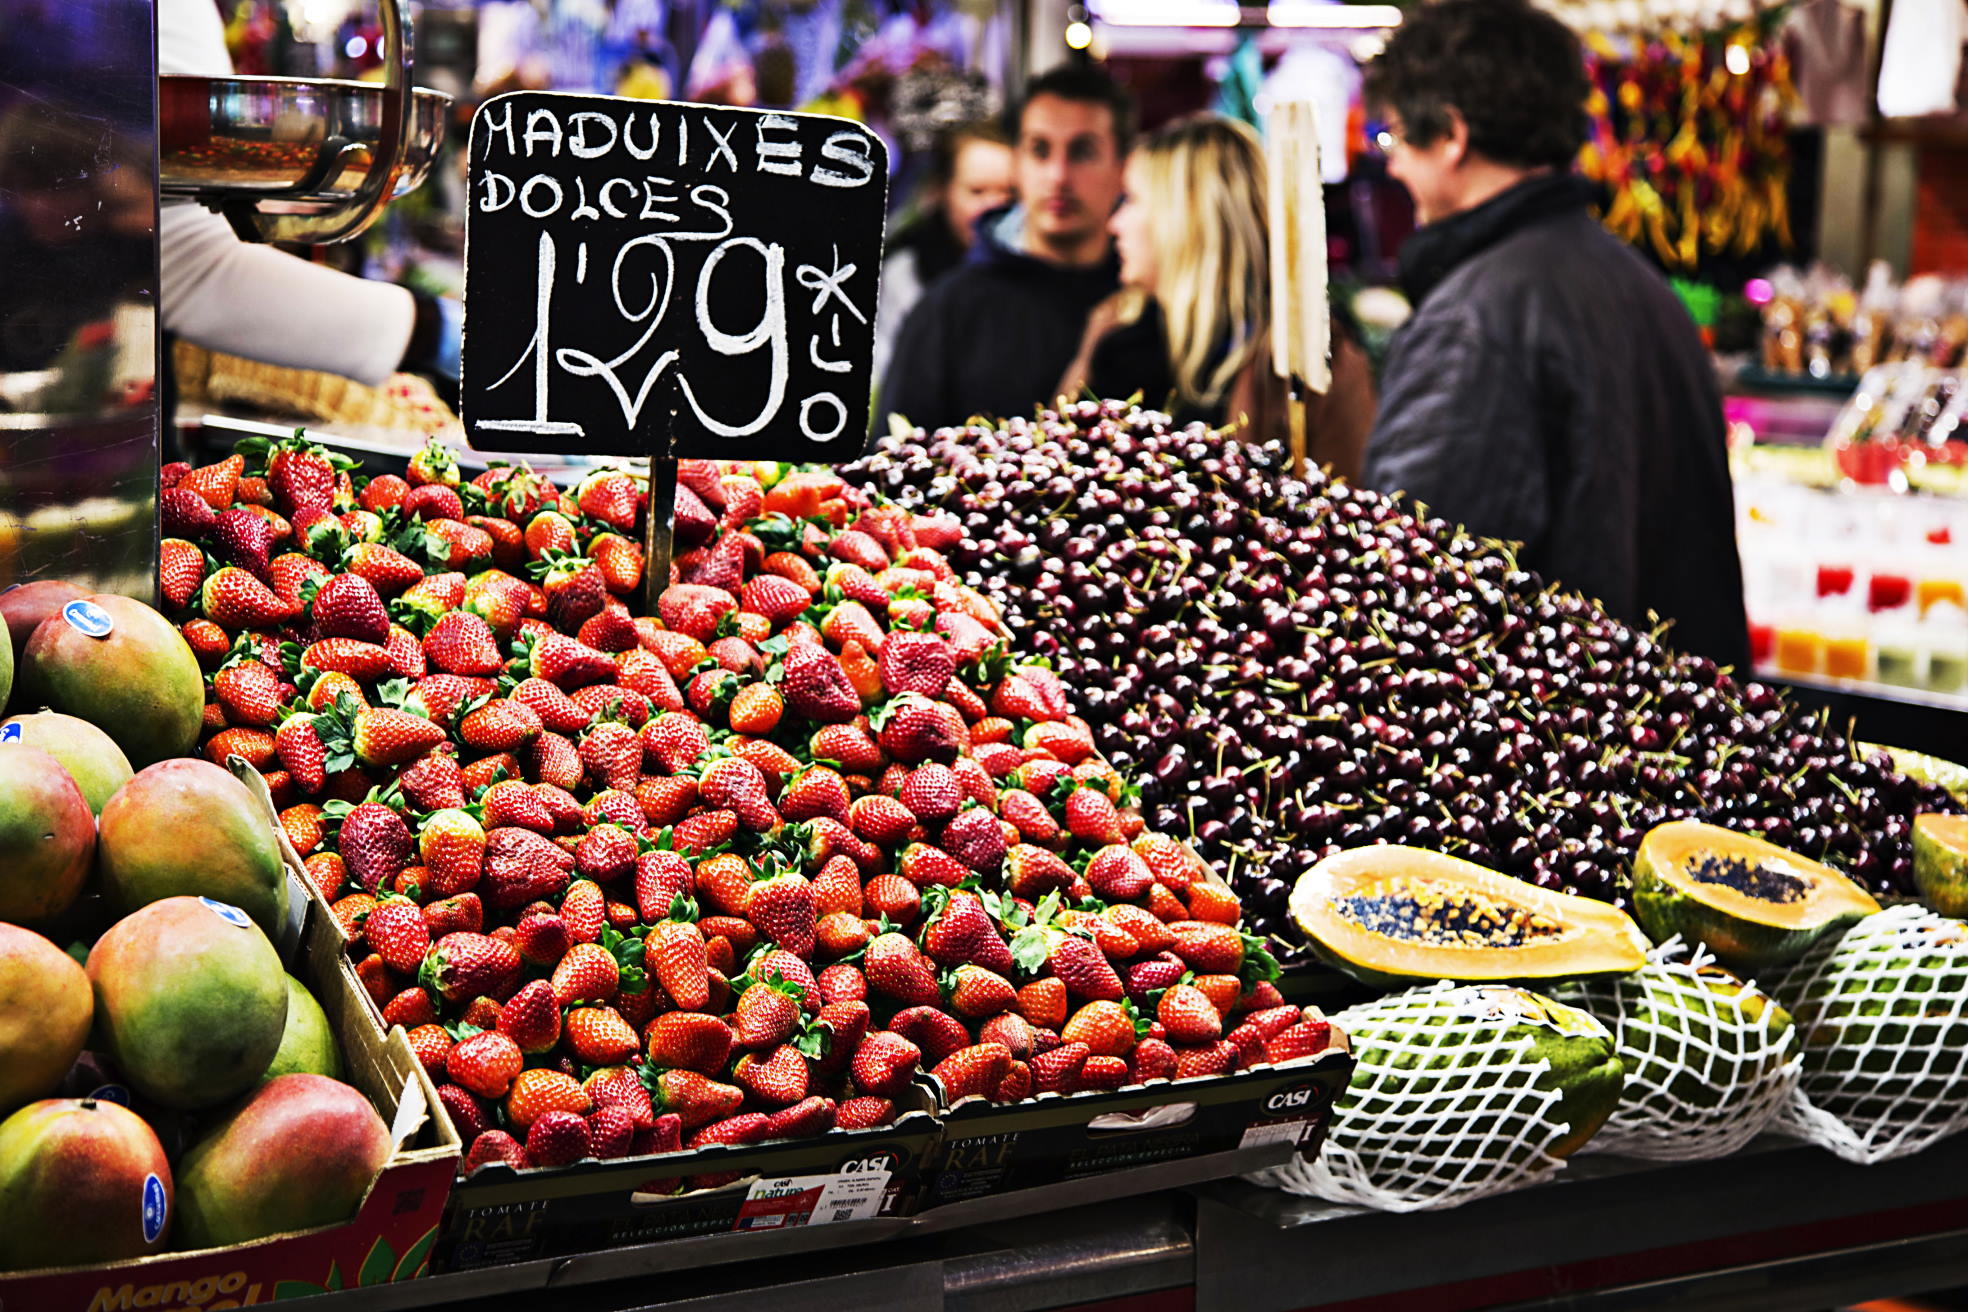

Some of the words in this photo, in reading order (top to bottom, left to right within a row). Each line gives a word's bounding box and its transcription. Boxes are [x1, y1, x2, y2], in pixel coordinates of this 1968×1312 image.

[483, 101, 876, 188] MADUIXES
[477, 169, 733, 241] DOLCES
[1268, 1088, 1312, 1110] CASI
[951, 1131, 1020, 1149] TOMATE
[840, 1155, 891, 1174] CASI
[944, 1143, 1014, 1170] RAF
[468, 1199, 549, 1219] TOMATE
[87, 1271, 247, 1312] Mango
